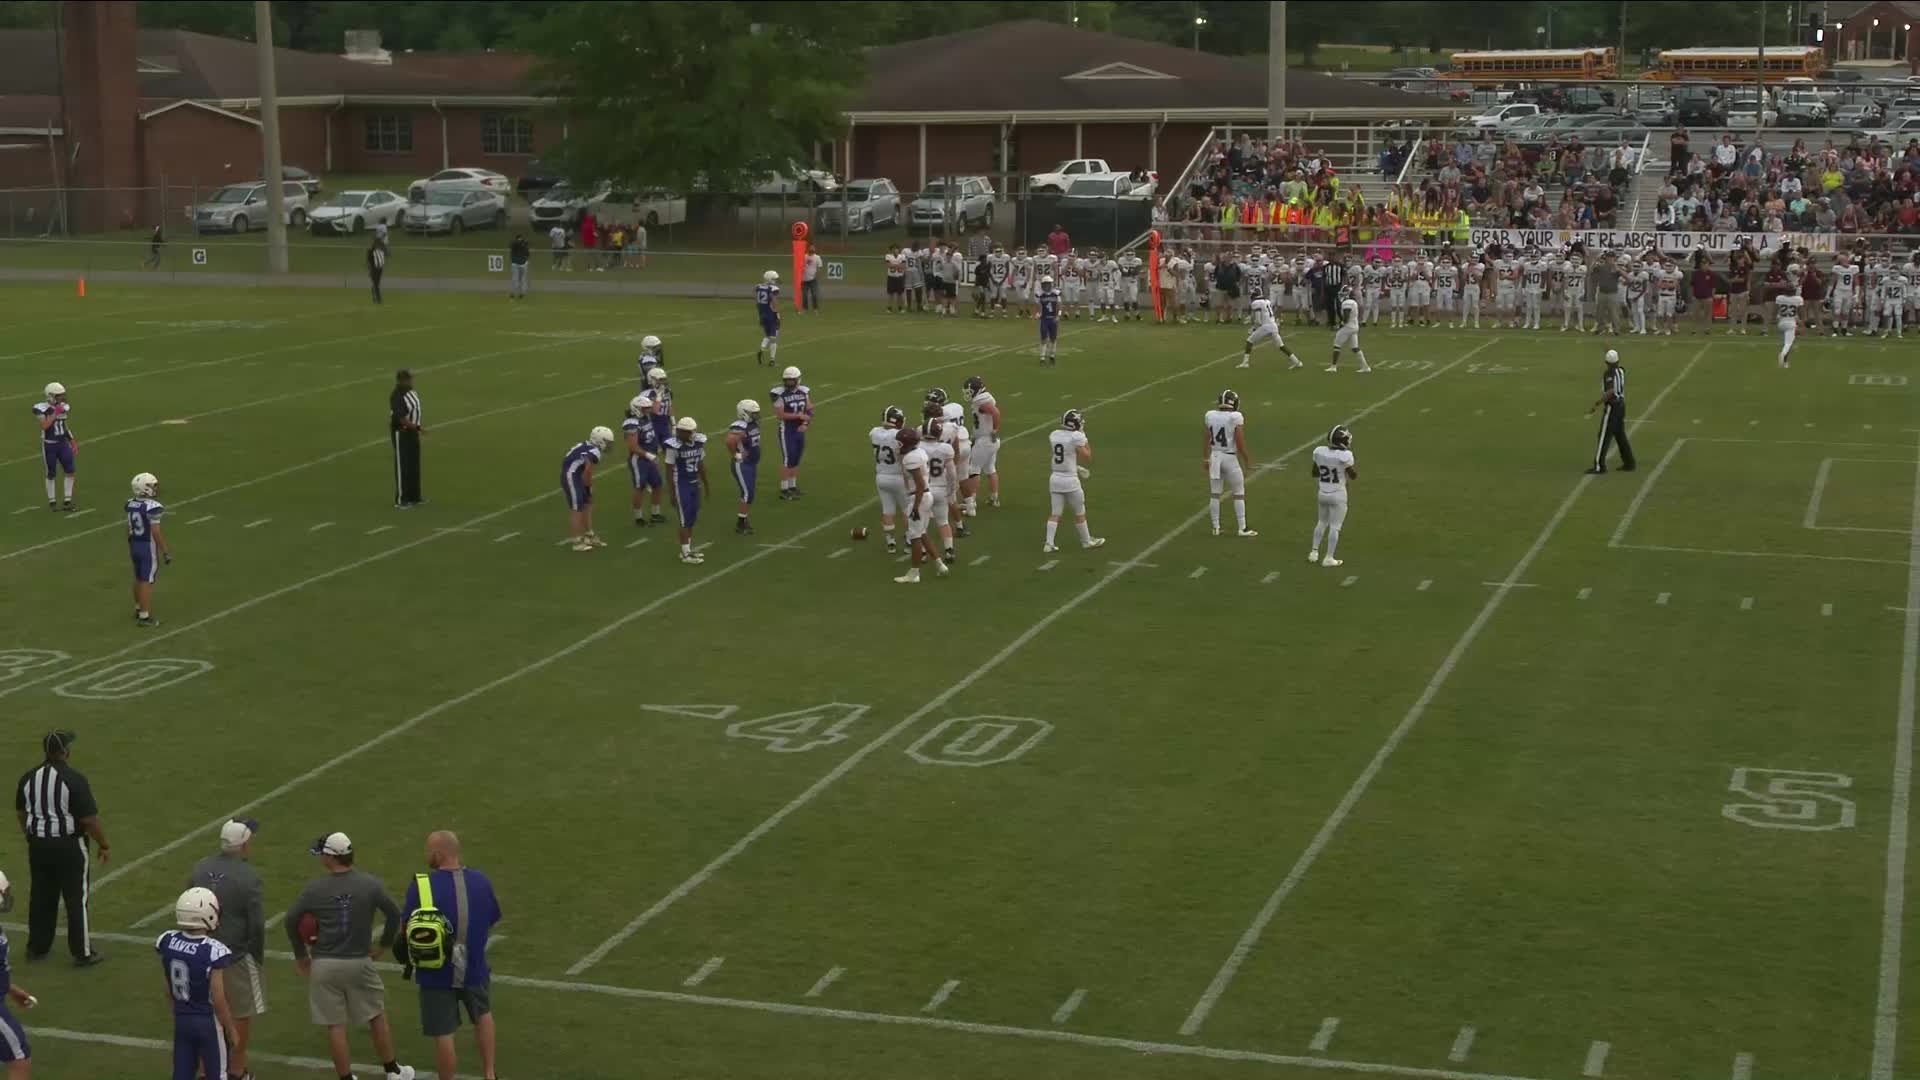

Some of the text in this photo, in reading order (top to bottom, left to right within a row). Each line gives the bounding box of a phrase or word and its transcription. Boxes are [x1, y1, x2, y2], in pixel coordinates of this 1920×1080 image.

[1472, 230, 1511, 246] GRAB
[1519, 231, 1554, 247] YOUR
[1672, 233, 1691, 248] TO
[1700, 234, 1727, 249] PUT
[1760, 234, 1768, 249] A
[194, 250, 204, 262] G
[490, 257, 502, 269] 10
[829, 264, 842, 277] 20
[1780, 304, 1797, 317] 23
[1209, 425, 1228, 447] 14
[872, 443, 896, 465] 73
[1054, 444, 1065, 464] 9
[1320, 465, 1340, 484] 21
[170, 958, 191, 1002] 8
